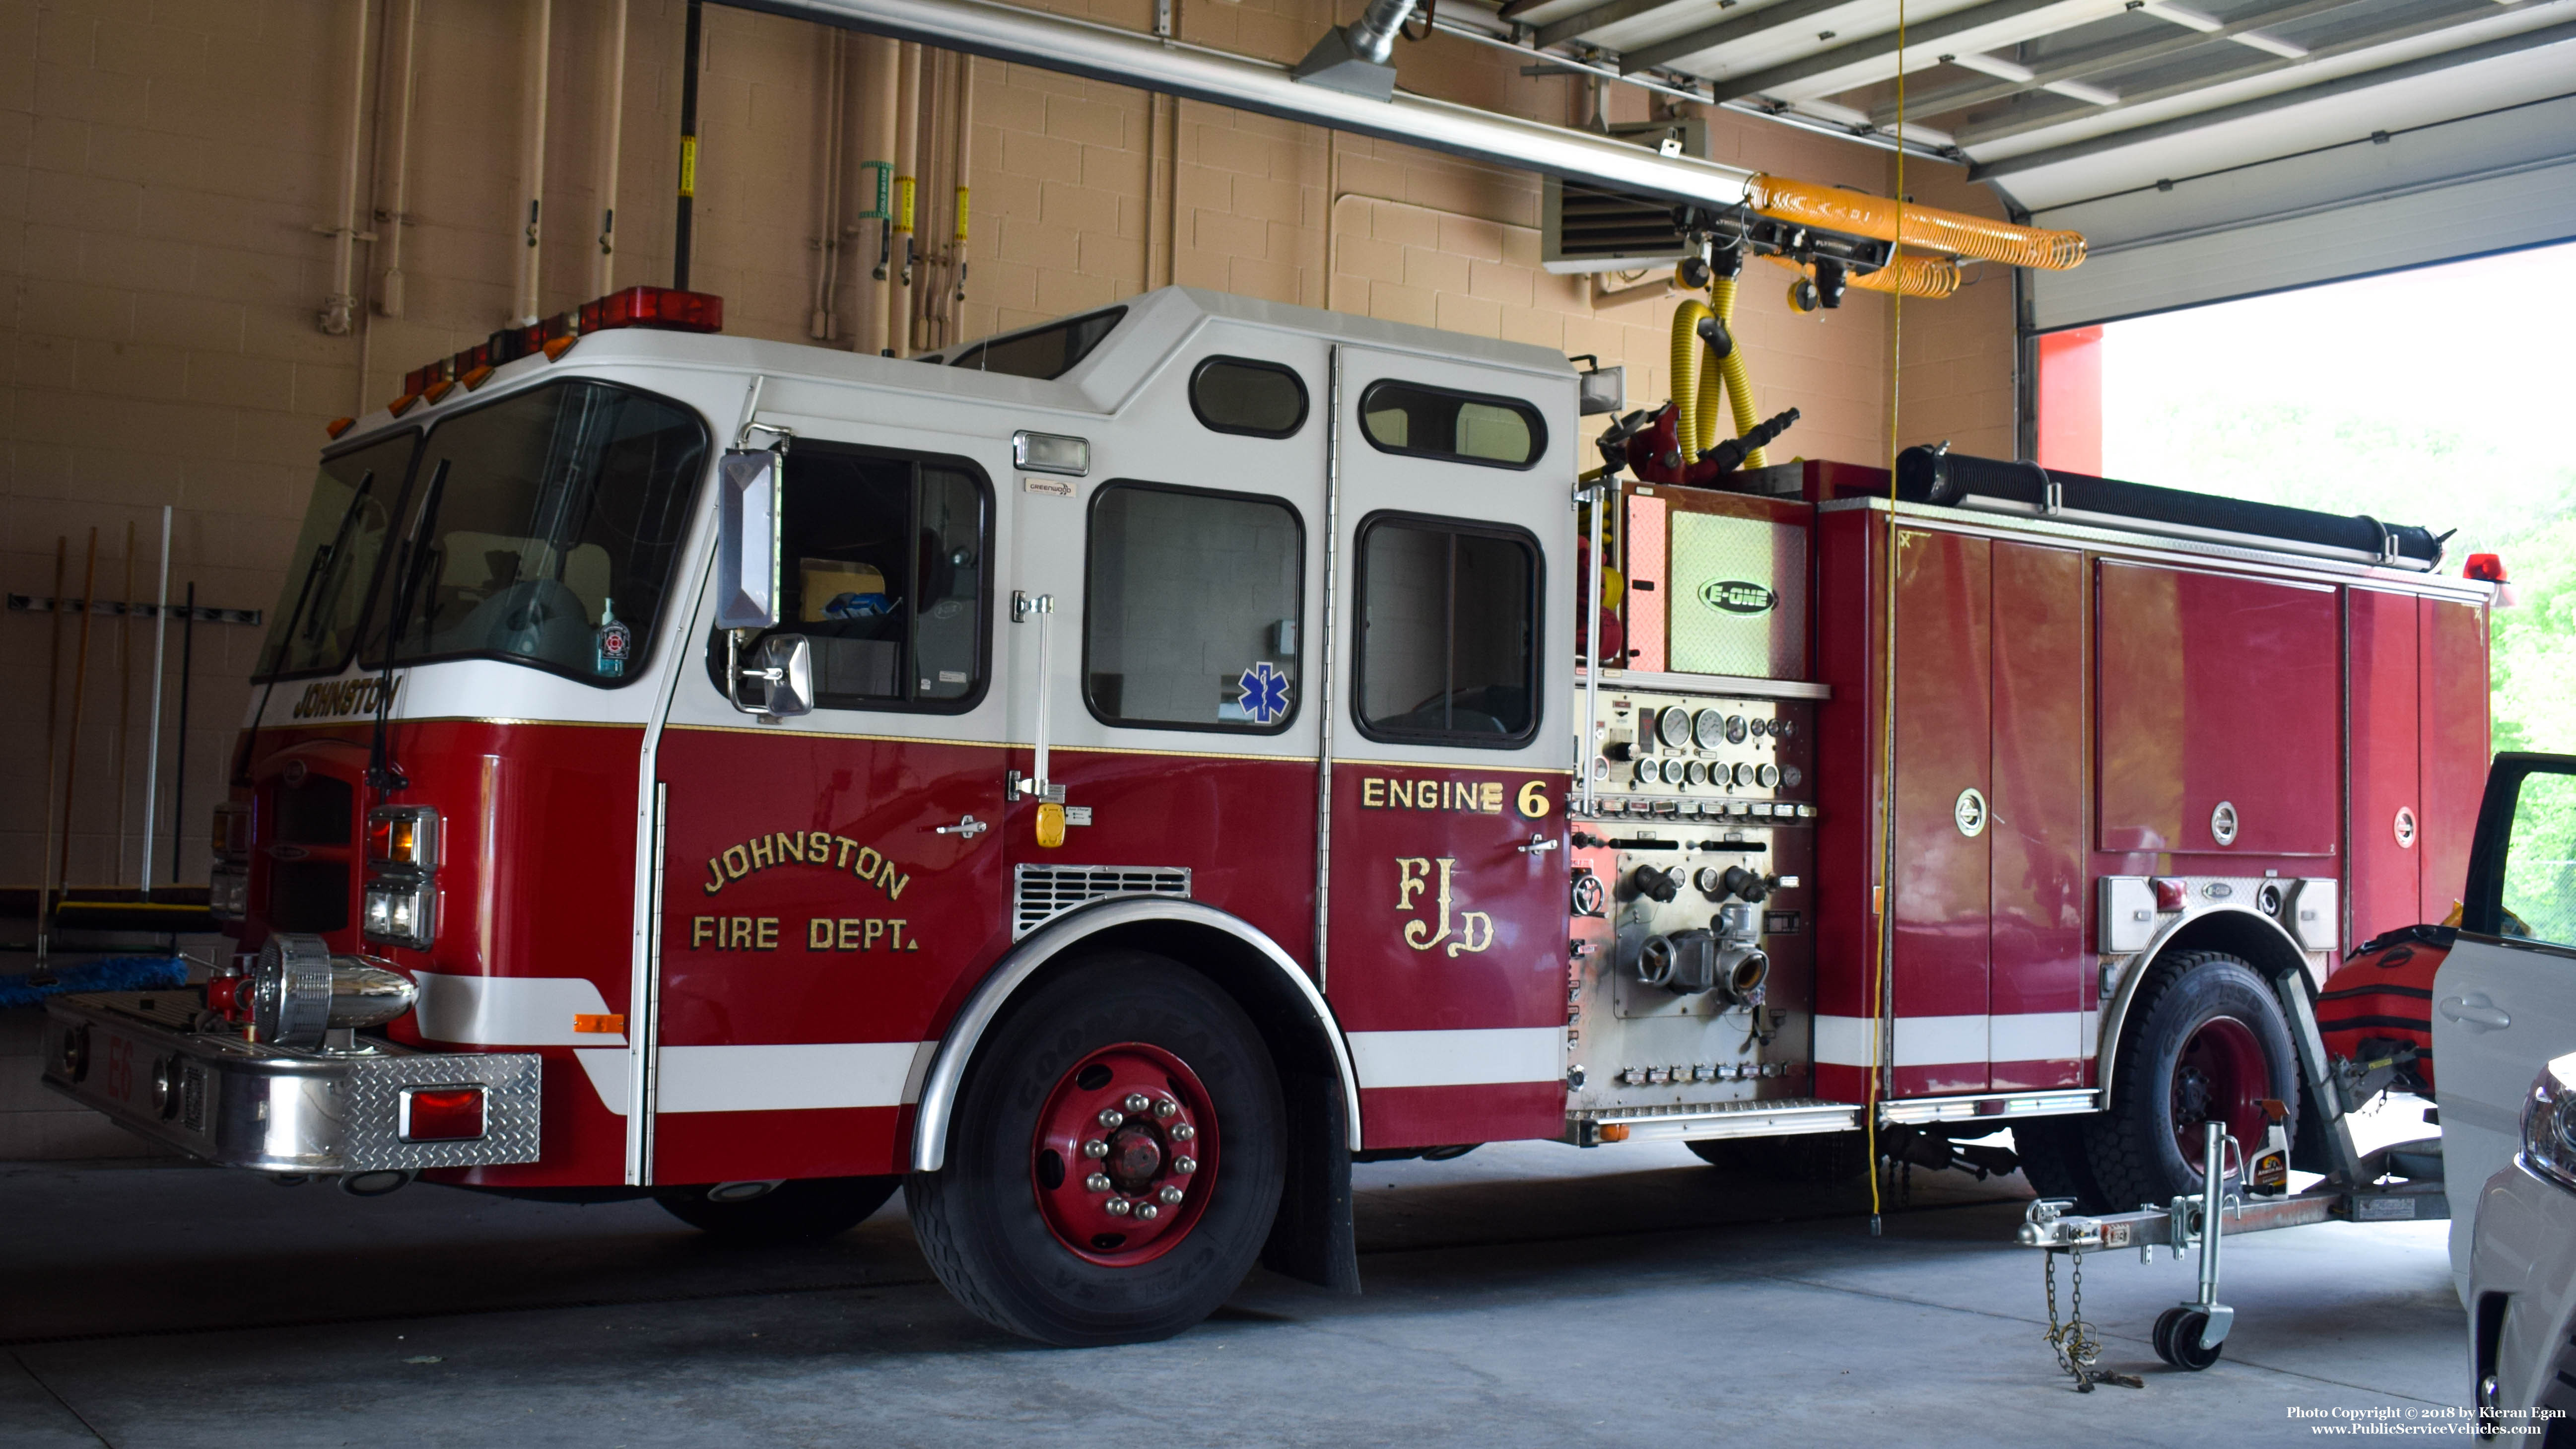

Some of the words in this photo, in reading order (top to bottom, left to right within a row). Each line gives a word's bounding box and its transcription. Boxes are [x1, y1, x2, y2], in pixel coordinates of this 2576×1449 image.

[1030, 483, 1071, 493] GREENWOOD
[1710, 585, 1768, 607] E-ONE
[292, 675, 403, 719] JOHNSTON
[1361, 778, 1503, 814] ENGINE
[1515, 780, 1550, 821] 6
[703, 830, 910, 901] JOHNSTON
[691, 916, 779, 951] FIRE
[807, 918, 918, 952] DEPT.
[108, 1035, 133, 1103] E6
